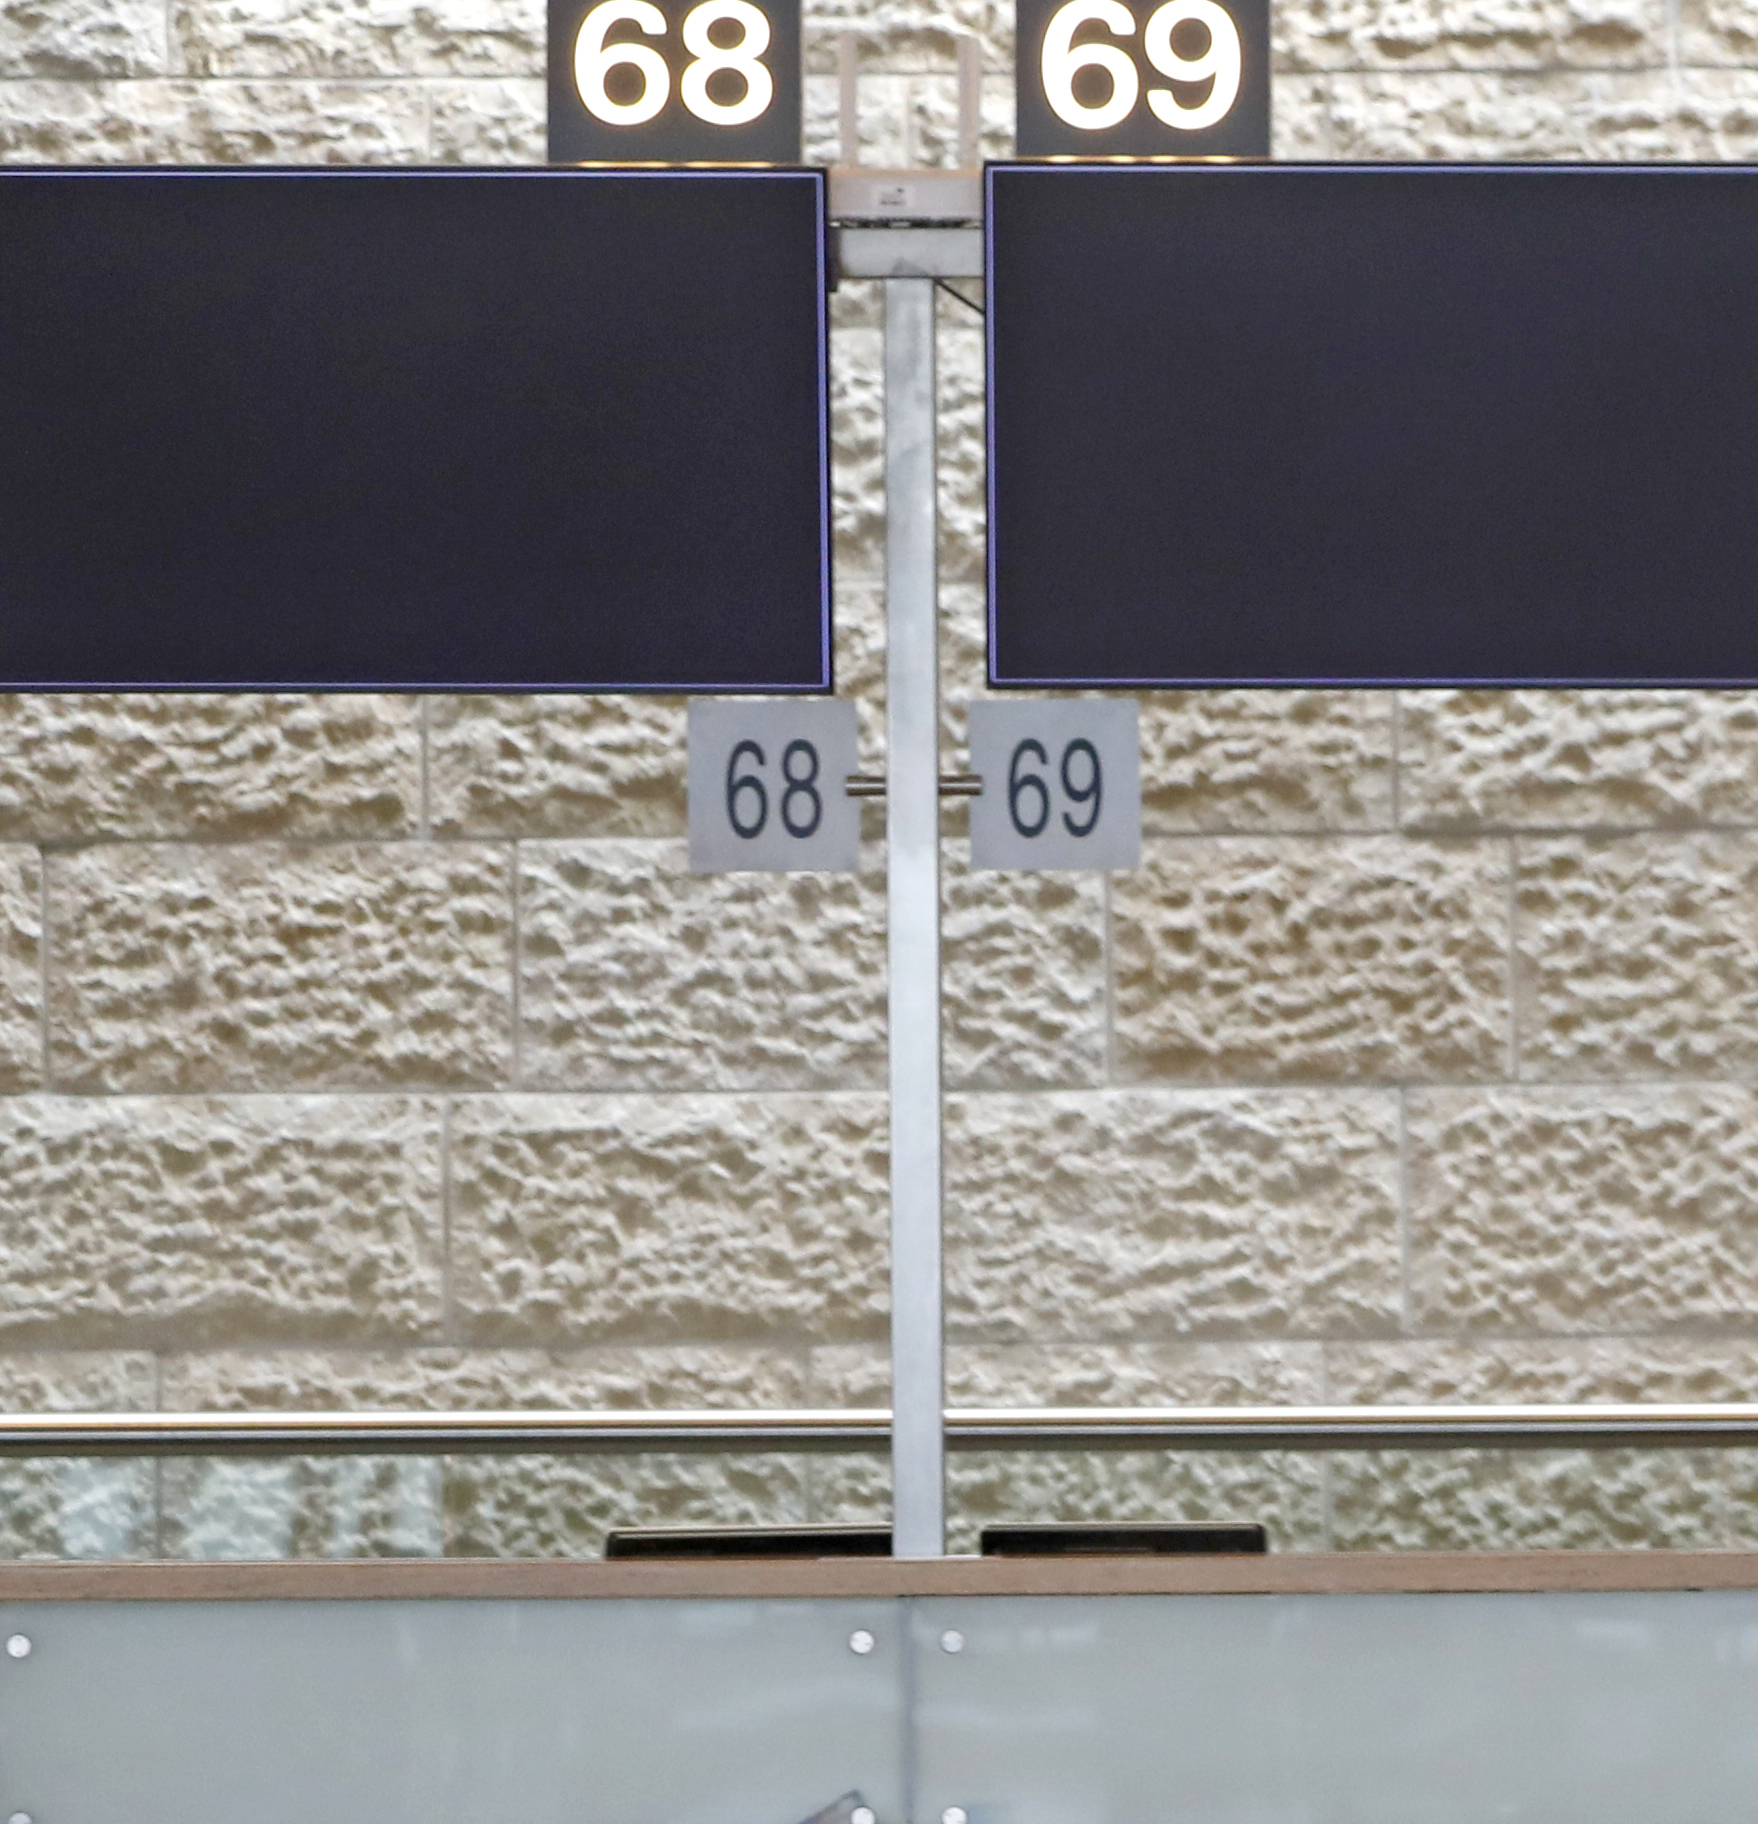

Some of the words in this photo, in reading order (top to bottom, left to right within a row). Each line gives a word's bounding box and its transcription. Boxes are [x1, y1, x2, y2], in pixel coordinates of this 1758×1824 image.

[572, 0, 775, 126] 68
[1039, 0, 1244, 131] 69
[725, 737, 823, 839] 68
[1007, 737, 1103, 838] 69
